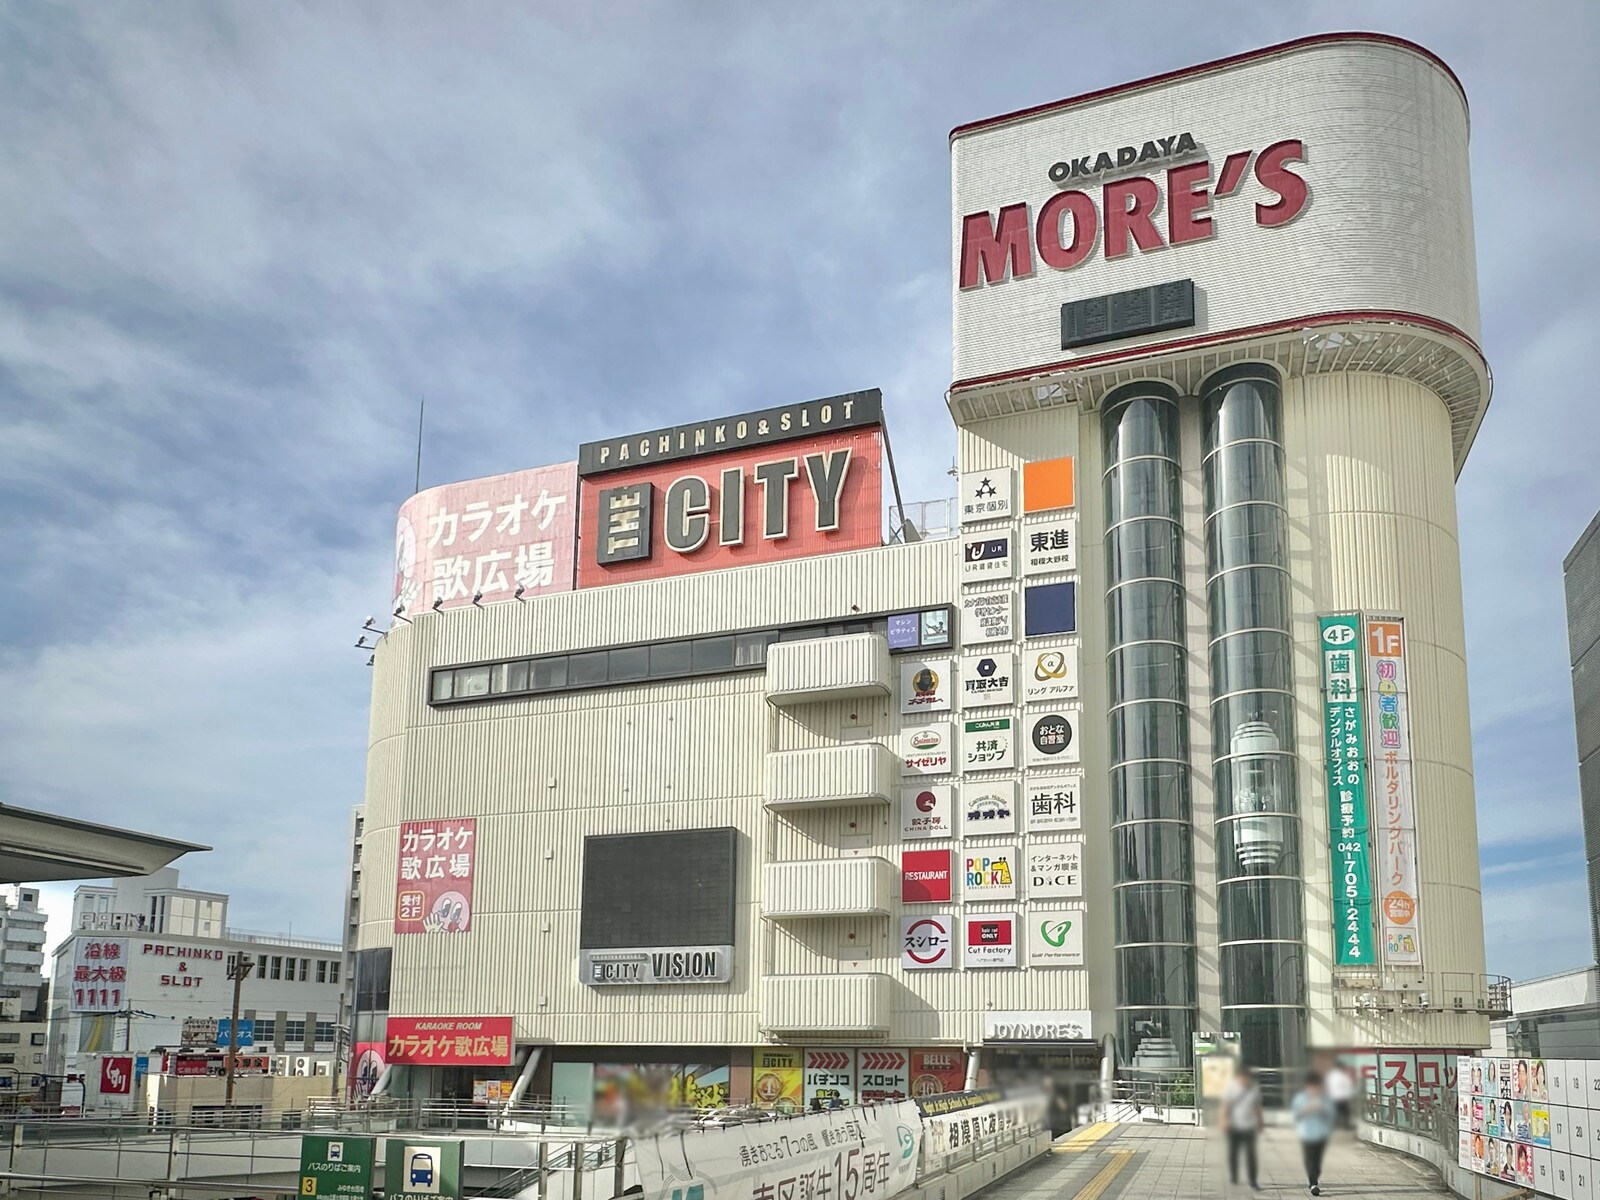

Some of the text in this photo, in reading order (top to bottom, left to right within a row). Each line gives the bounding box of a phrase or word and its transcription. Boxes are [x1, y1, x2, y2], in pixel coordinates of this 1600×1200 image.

[1049, 132, 1196, 182] OKADAYA
[960, 139, 1308, 291] MORE'S
[601, 400, 855, 464] PACHINKO&SLOT
[664, 447, 853, 554] CITY
[964, 499, 1009, 515] 東京個別
[428, 489, 567, 549] カラオケ
[608, 490, 641, 555] THE
[1030, 529, 1069, 553] 東進
[1030, 554, 1069, 566] 相模大野校
[431, 544, 555, 600] 歌広場
[890, 626, 917, 636] ピラティス
[1327, 628, 1351, 642] 4F
[1371, 626, 1400, 654] 1F
[965, 676, 1009, 691] 買取大吉
[1330, 654, 1352, 700] 歯科
[1027, 685, 1075, 696] リング アルファ
[1040, 725, 1065, 736] おとな
[976, 740, 998, 752] 共済
[1040, 734, 1065, 746] 自習室
[1329, 707, 1344, 787] デンタルオフィス
[1344, 706, 1360, 785] さがみおおの
[905, 756, 947, 768] サイゼリヤ
[968, 748, 1007, 763] ショップ
[1031, 791, 1076, 816] 歯科
[911, 817, 941, 826] 餃子房
[1340, 790, 1355, 839] 診療予約
[401, 826, 474, 852] カラオケ
[966, 858, 990, 872] POP
[1031, 853, 1078, 863] インターネット
[401, 854, 471, 880] 歌広場
[1031, 862, 1078, 873] &マンガ喫茶
[905, 870, 948, 881] RESTAURANT
[966, 871, 999, 886] ROCK
[401, 894, 422, 907] 受付
[400, 907, 421, 918] 2F
[904, 936, 949, 949] スシロー
[85, 943, 121, 960] 沿線
[143, 943, 224, 961] PACHINKO
[983, 946, 1012, 955] Factory
[178, 961, 188, 972] &
[605, 963, 640, 978] CITY
[652, 952, 716, 977] VISION
[74, 966, 127, 983] 最大級
[160, 974, 204, 987] SLOT
[75, 988, 121, 1006] 1111
[415, 1022, 483, 1030] KARAOKE ROOM
[219, 1029, 253, 1038] パオス
[388, 1034, 509, 1058] カラオケ歌広場
[771, 1058, 793, 1067] CITY
[924, 1054, 951, 1065] BELLE
[105, 1059, 127, 1092] くすり
[807, 1074, 850, 1086] パチンコ
[863, 1074, 905, 1087] スロット
[1540, 1165, 1546, 1176] 15
[305, 1179, 313, 1193] 3
